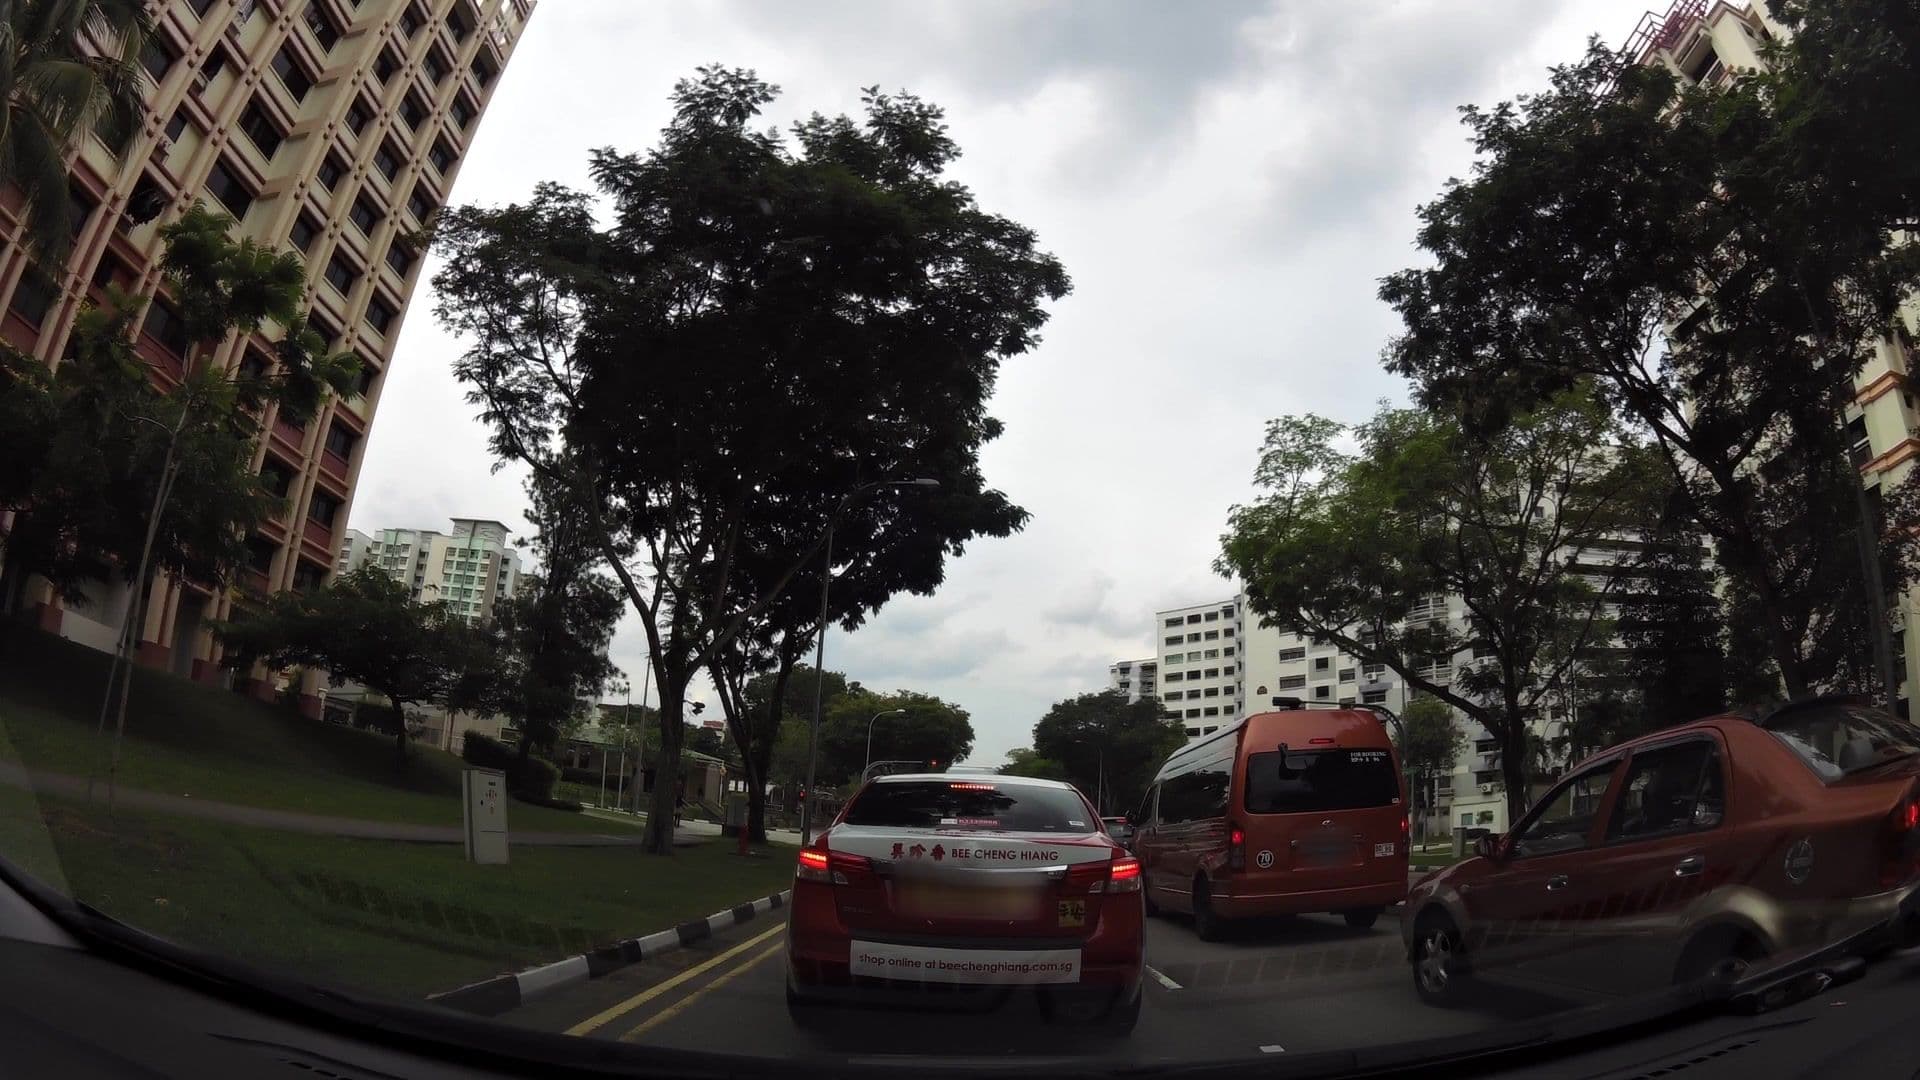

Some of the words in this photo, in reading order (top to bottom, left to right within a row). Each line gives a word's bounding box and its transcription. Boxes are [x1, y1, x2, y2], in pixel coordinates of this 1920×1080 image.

[952, 849, 971, 859] BEE
[974, 849, 1017, 860] CHENG
[1020, 850, 1059, 861] HIANG
[1260, 853, 1271, 863] 70
[859, 953, 885, 967] shop
[887, 955, 922, 969] online
[924, 960, 936, 970] at
[938, 960, 1073, 974] beechenghiang.com.sg
